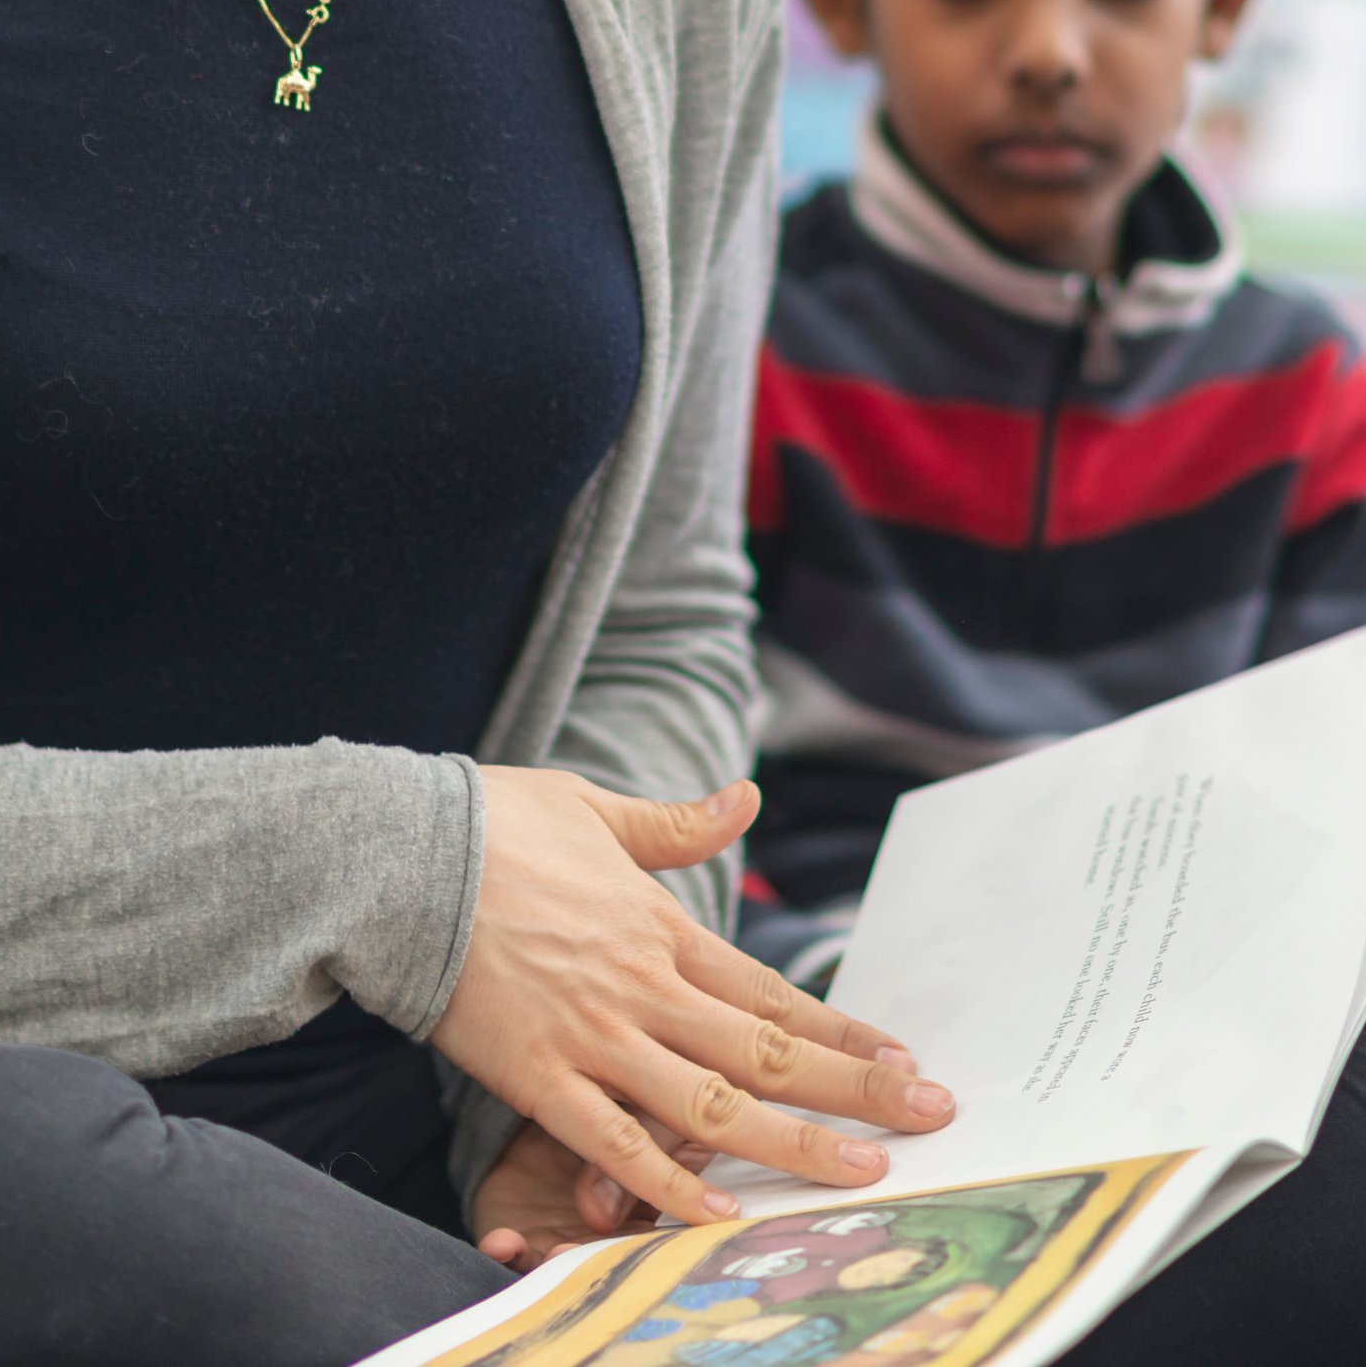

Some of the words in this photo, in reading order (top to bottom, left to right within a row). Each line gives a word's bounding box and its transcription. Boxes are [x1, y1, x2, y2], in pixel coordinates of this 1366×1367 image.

[1085, 848, 1107, 889] home.
[1103, 844, 1126, 902] windows.
[1129, 837, 1149, 892] watched
[1172, 850, 1195, 905] boarded
[1122, 894, 1135, 912] as,
[1094, 904, 1114, 933] Still
[1117, 915, 1129, 938] one
[1166, 907, 1182, 929] the
[1089, 935, 1101, 952] no
[1108, 940, 1127, 956] by
[1156, 930, 1177, 959] bus,
[1080, 955, 1093, 977] one
[1099, 959, 1116, 986] one,
[1147, 961, 1163, 991] each
[1062, 979, 1090, 1019] looked
[1088, 988, 1110, 1016] their
[1135, 993, 1156, 1024] child
[1053, 1020, 1074, 1039] her
[1074, 1019, 1098, 1047] faces
[1123, 1026, 1140, 1048] now
[1039, 1042, 1058, 1061] way
[1106, 1050, 1127, 1073] wore
[1033, 1064, 1046, 1075] as
[1046, 1049, 1079, 1090] appeared
[1038, 1090, 1054, 1102] in
